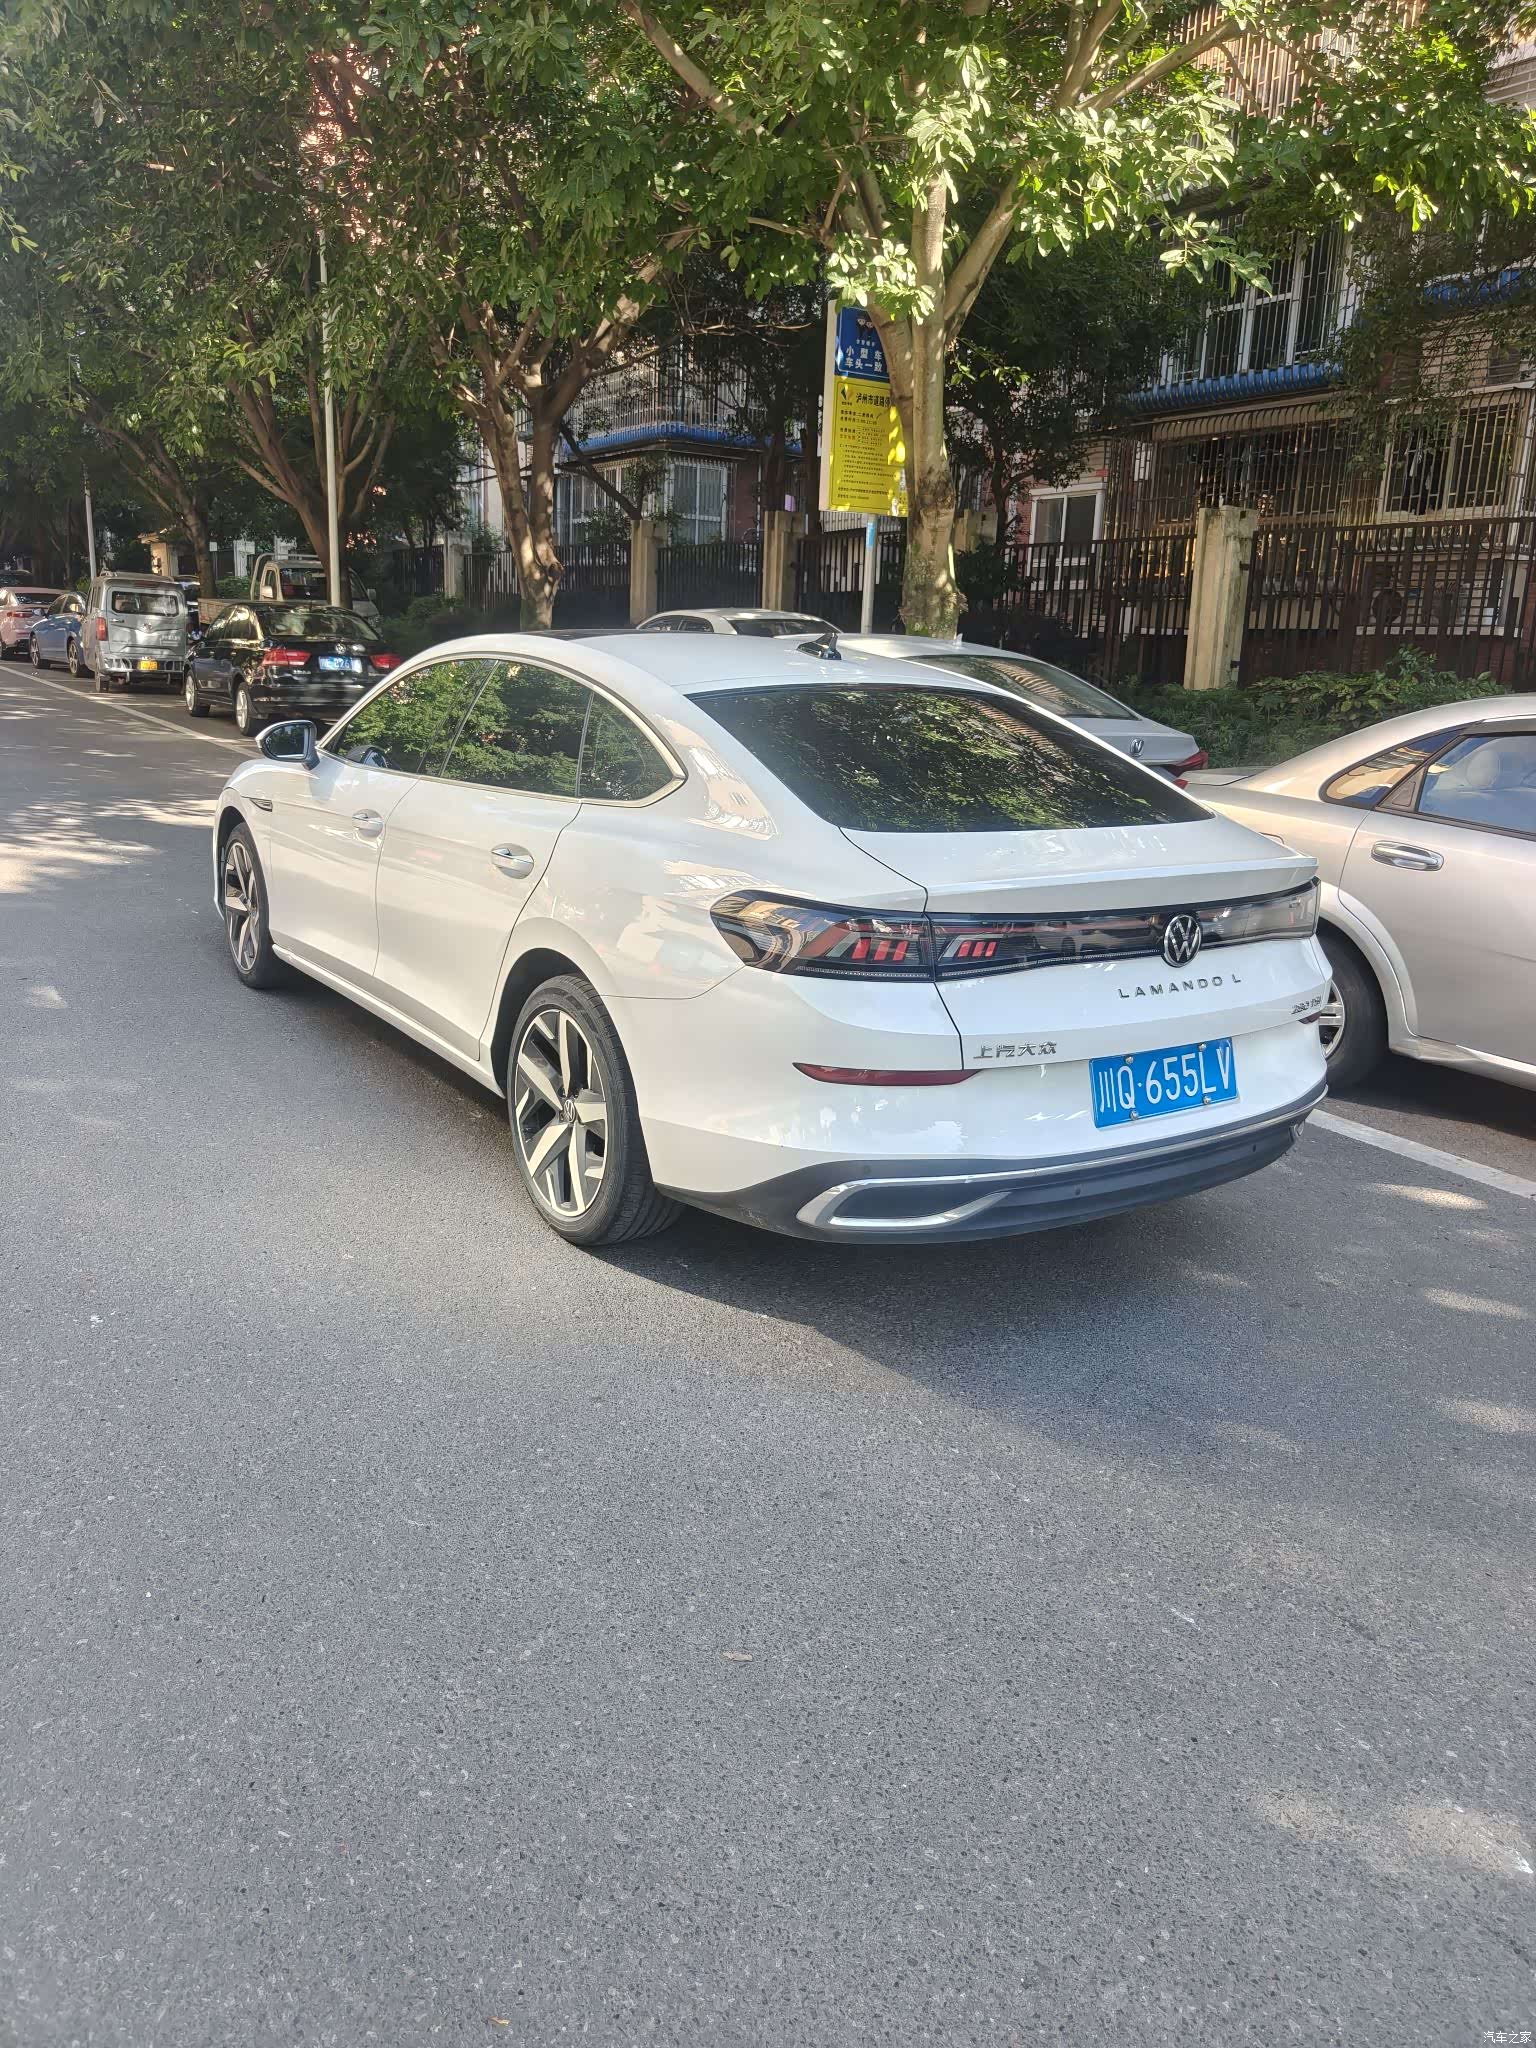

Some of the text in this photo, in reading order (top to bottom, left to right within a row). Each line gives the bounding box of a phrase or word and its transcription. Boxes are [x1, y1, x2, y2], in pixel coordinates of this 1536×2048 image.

[1118, 974, 1242, 998] LAMANDO L
[973, 1041, 1057, 1059] 上汽大众
